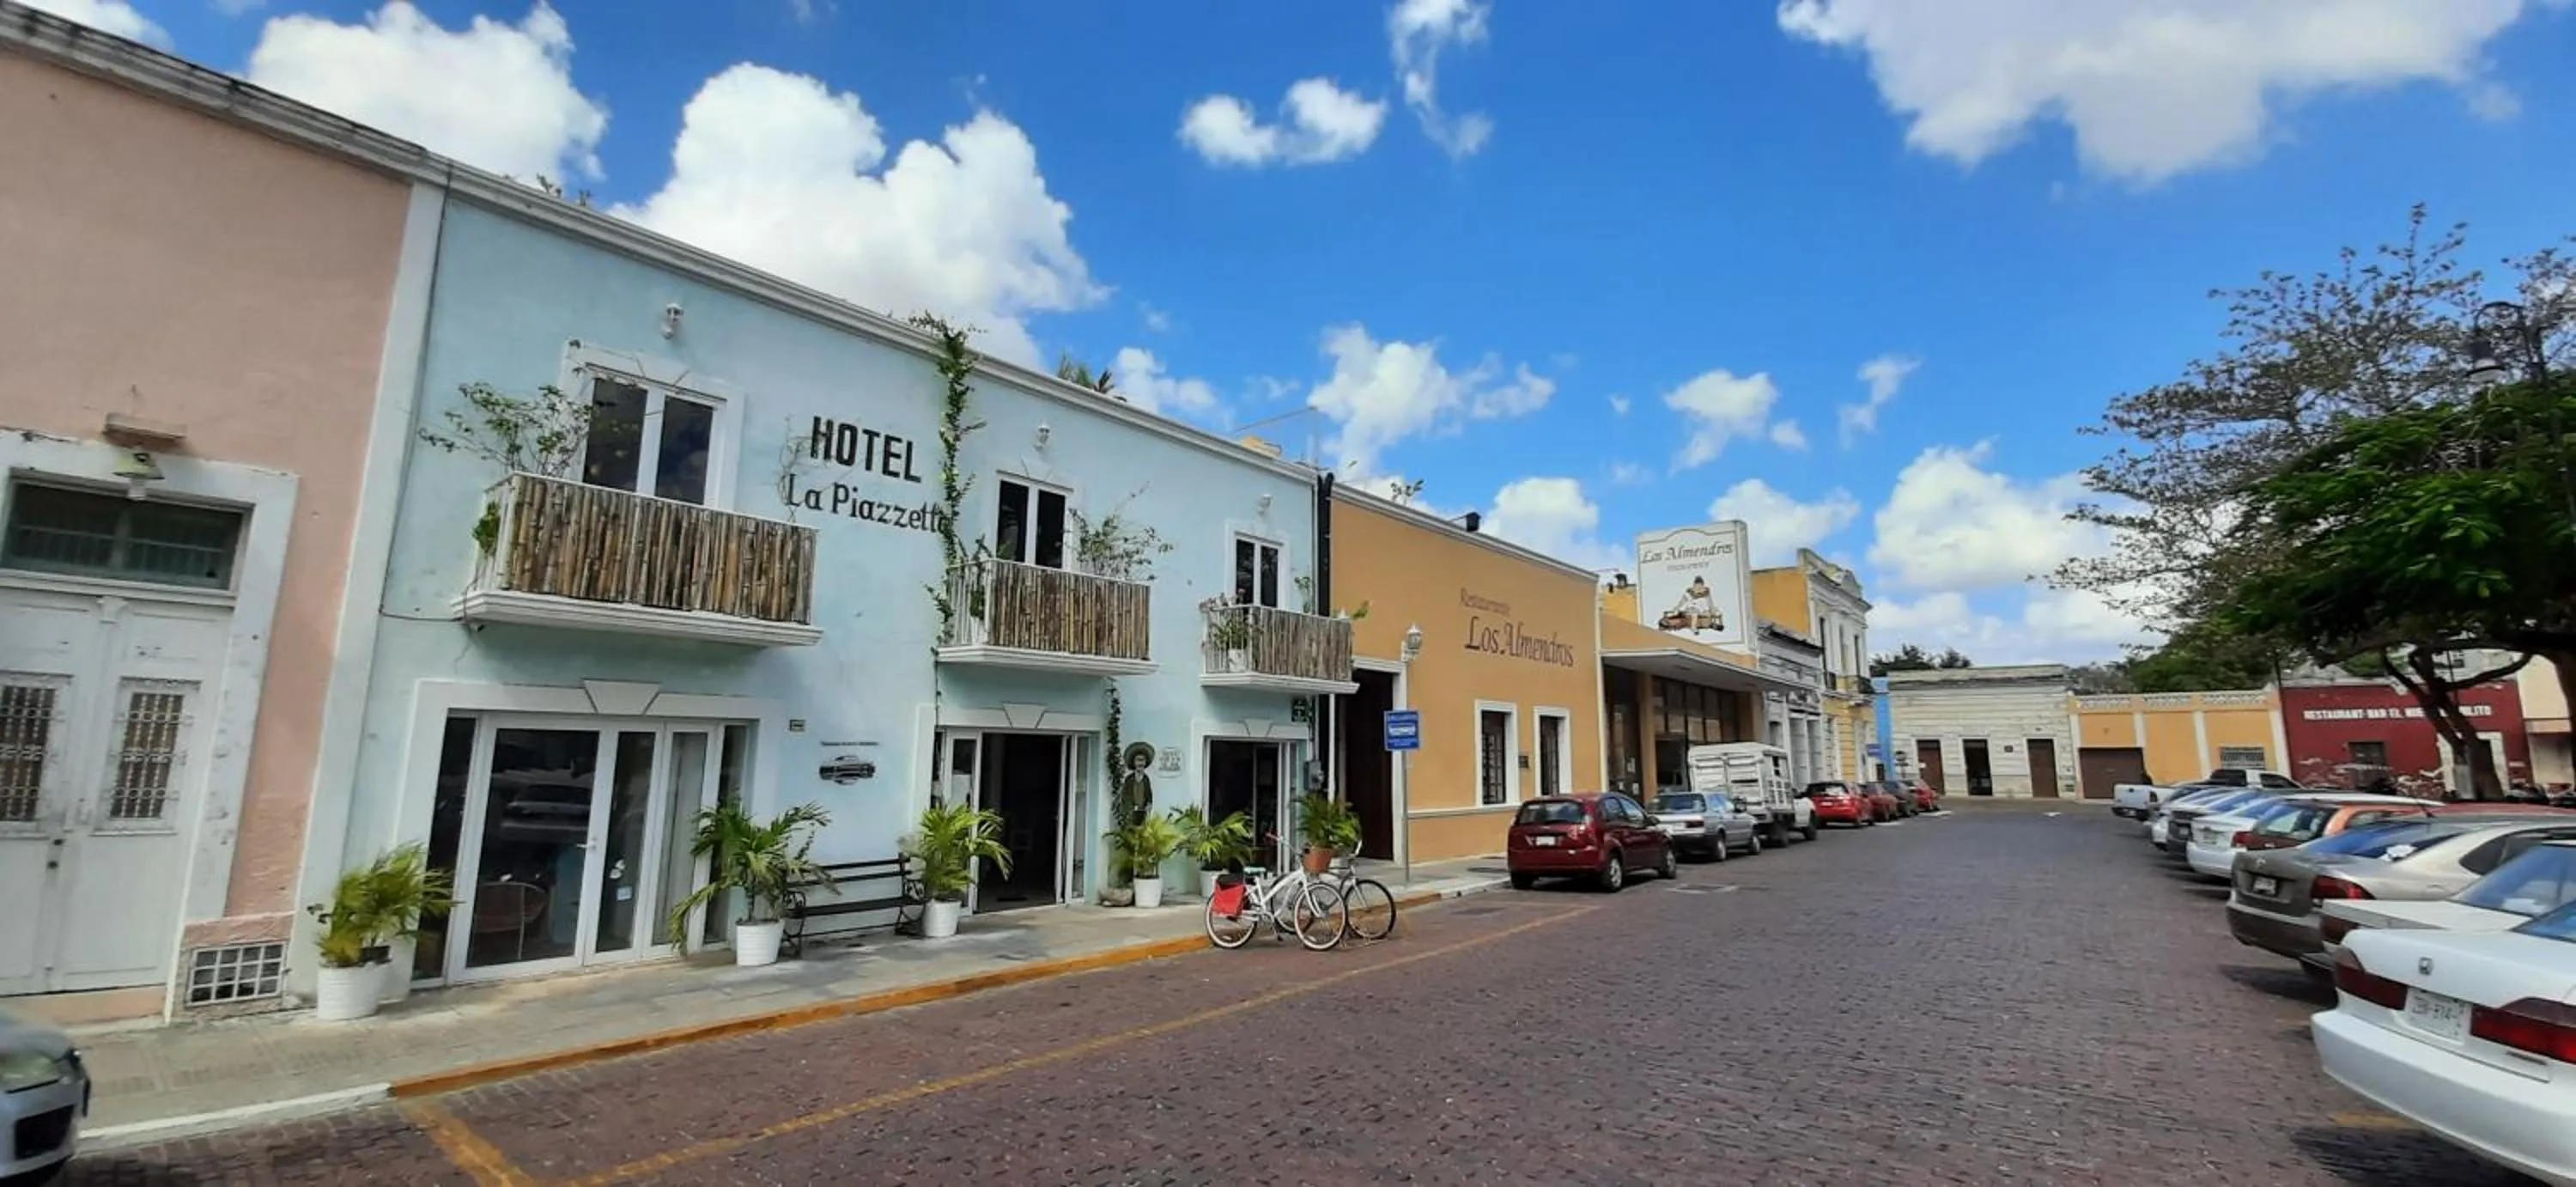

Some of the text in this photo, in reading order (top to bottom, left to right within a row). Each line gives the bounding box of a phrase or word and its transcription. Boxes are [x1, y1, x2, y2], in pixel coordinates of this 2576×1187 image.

[810, 416, 921, 484] HOTEL
[787, 473, 823, 511] La
[1464, 616, 1575, 667] Los Almendros
